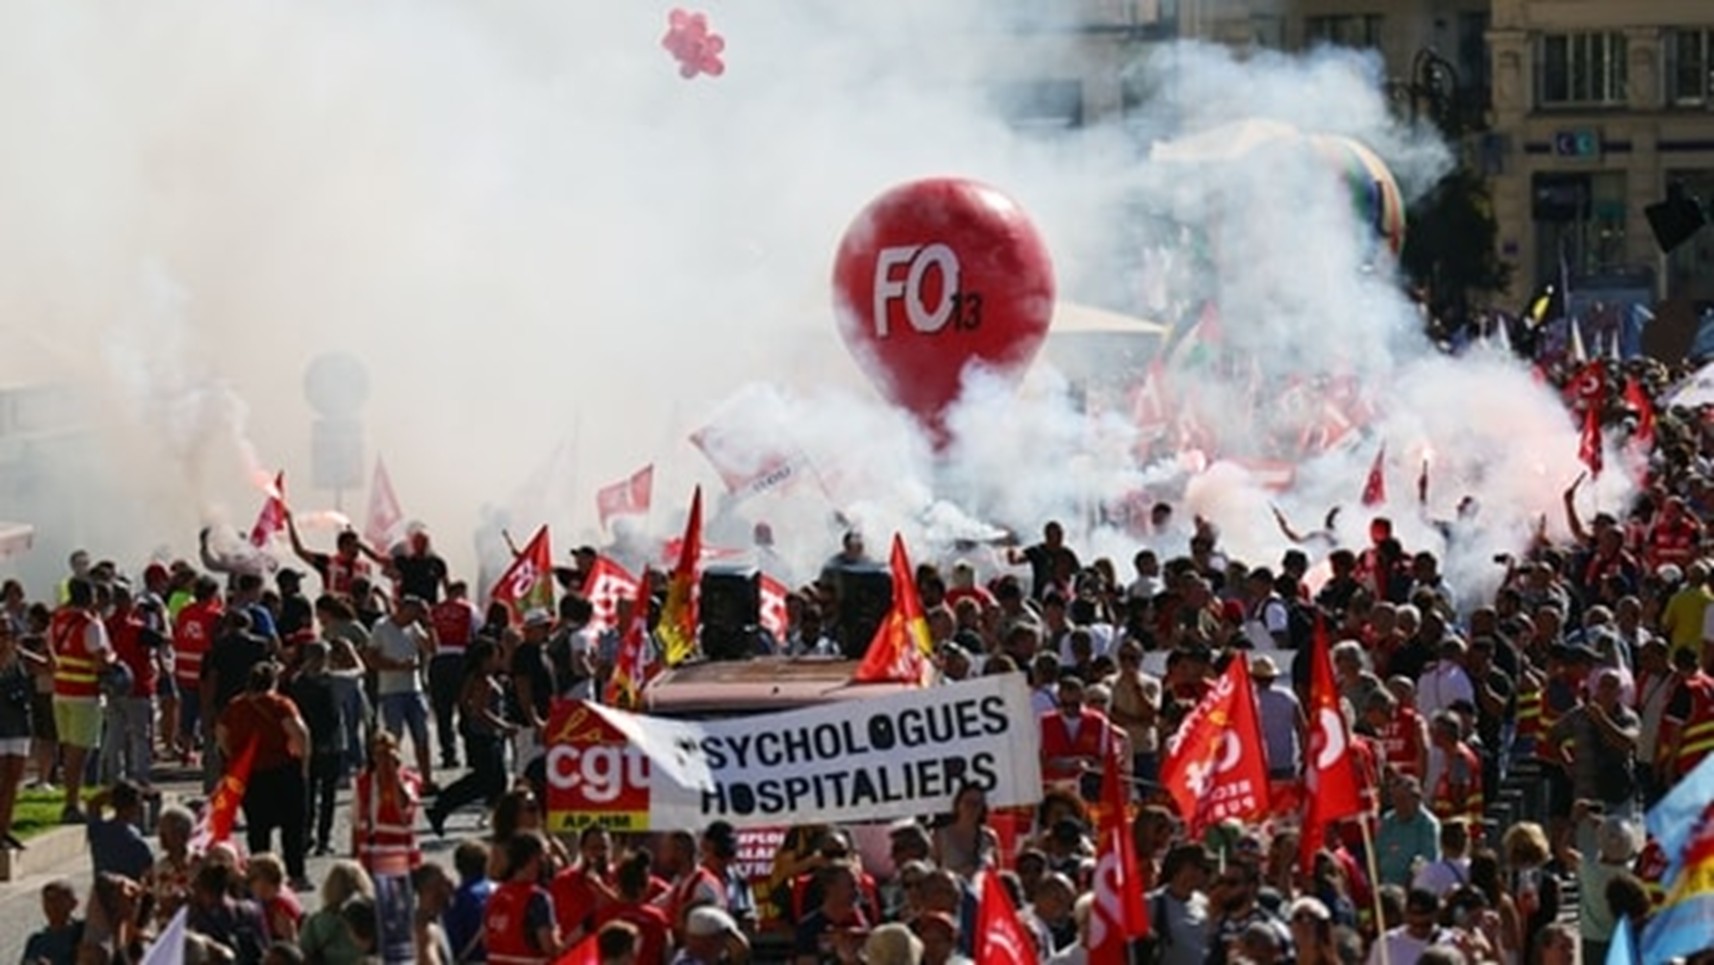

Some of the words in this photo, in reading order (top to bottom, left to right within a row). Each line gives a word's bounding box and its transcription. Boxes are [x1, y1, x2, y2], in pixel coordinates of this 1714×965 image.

[873, 243, 960, 338] FO
[951, 293, 982, 331] 13
[546, 744, 651, 802] cgt
[701, 752, 998, 815] HOSPITALIERS
